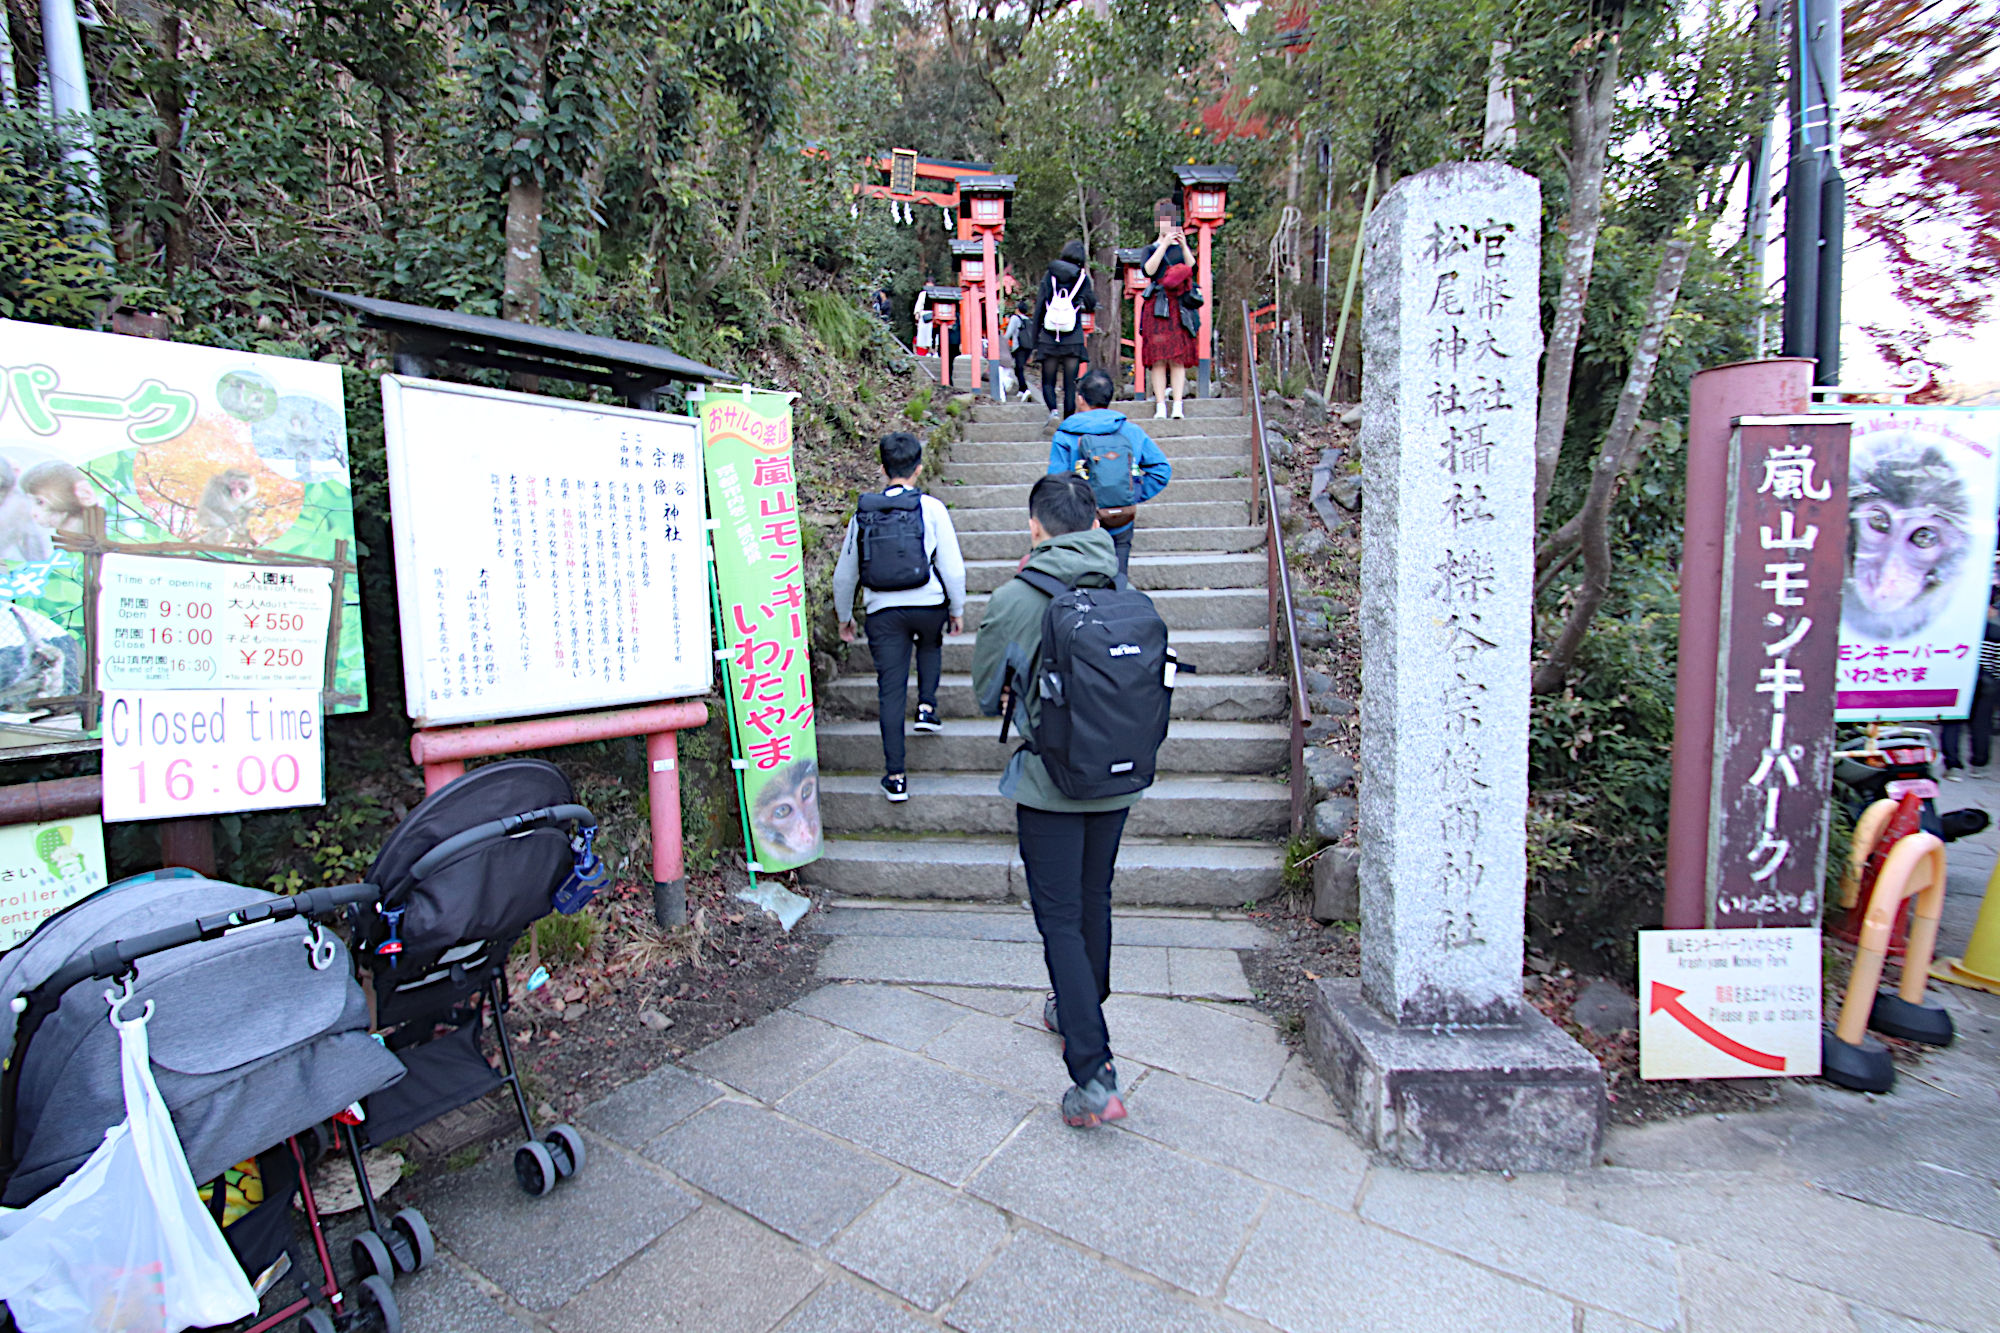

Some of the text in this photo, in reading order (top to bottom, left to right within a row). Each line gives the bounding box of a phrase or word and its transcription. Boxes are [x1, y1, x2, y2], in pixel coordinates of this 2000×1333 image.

[1422, 220, 1470, 417] 松尾神社
[0, 363, 198, 445] パーク
[663, 502, 682, 542] 神社
[117, 574, 212, 590] Time of opening
[246, 572, 294, 586] 入園料
[160, 601, 212, 619] 9:00
[260, 600, 287, 608] Adult
[118, 609, 146, 619] Open
[114, 640, 145, 649] Close
[149, 627, 212, 645] 16:00
[1838, 643, 1970, 661] モンキーパーク
[1747, 444, 1832, 882] 嵐山モンキーパーク
[732, 603, 793, 770] いわたやま
[111, 697, 312, 747] Closed time
[129, 754, 300, 804] 16:00
[1, 905, 66, 924] entran
[1747, 1008, 1760, 1024] go
